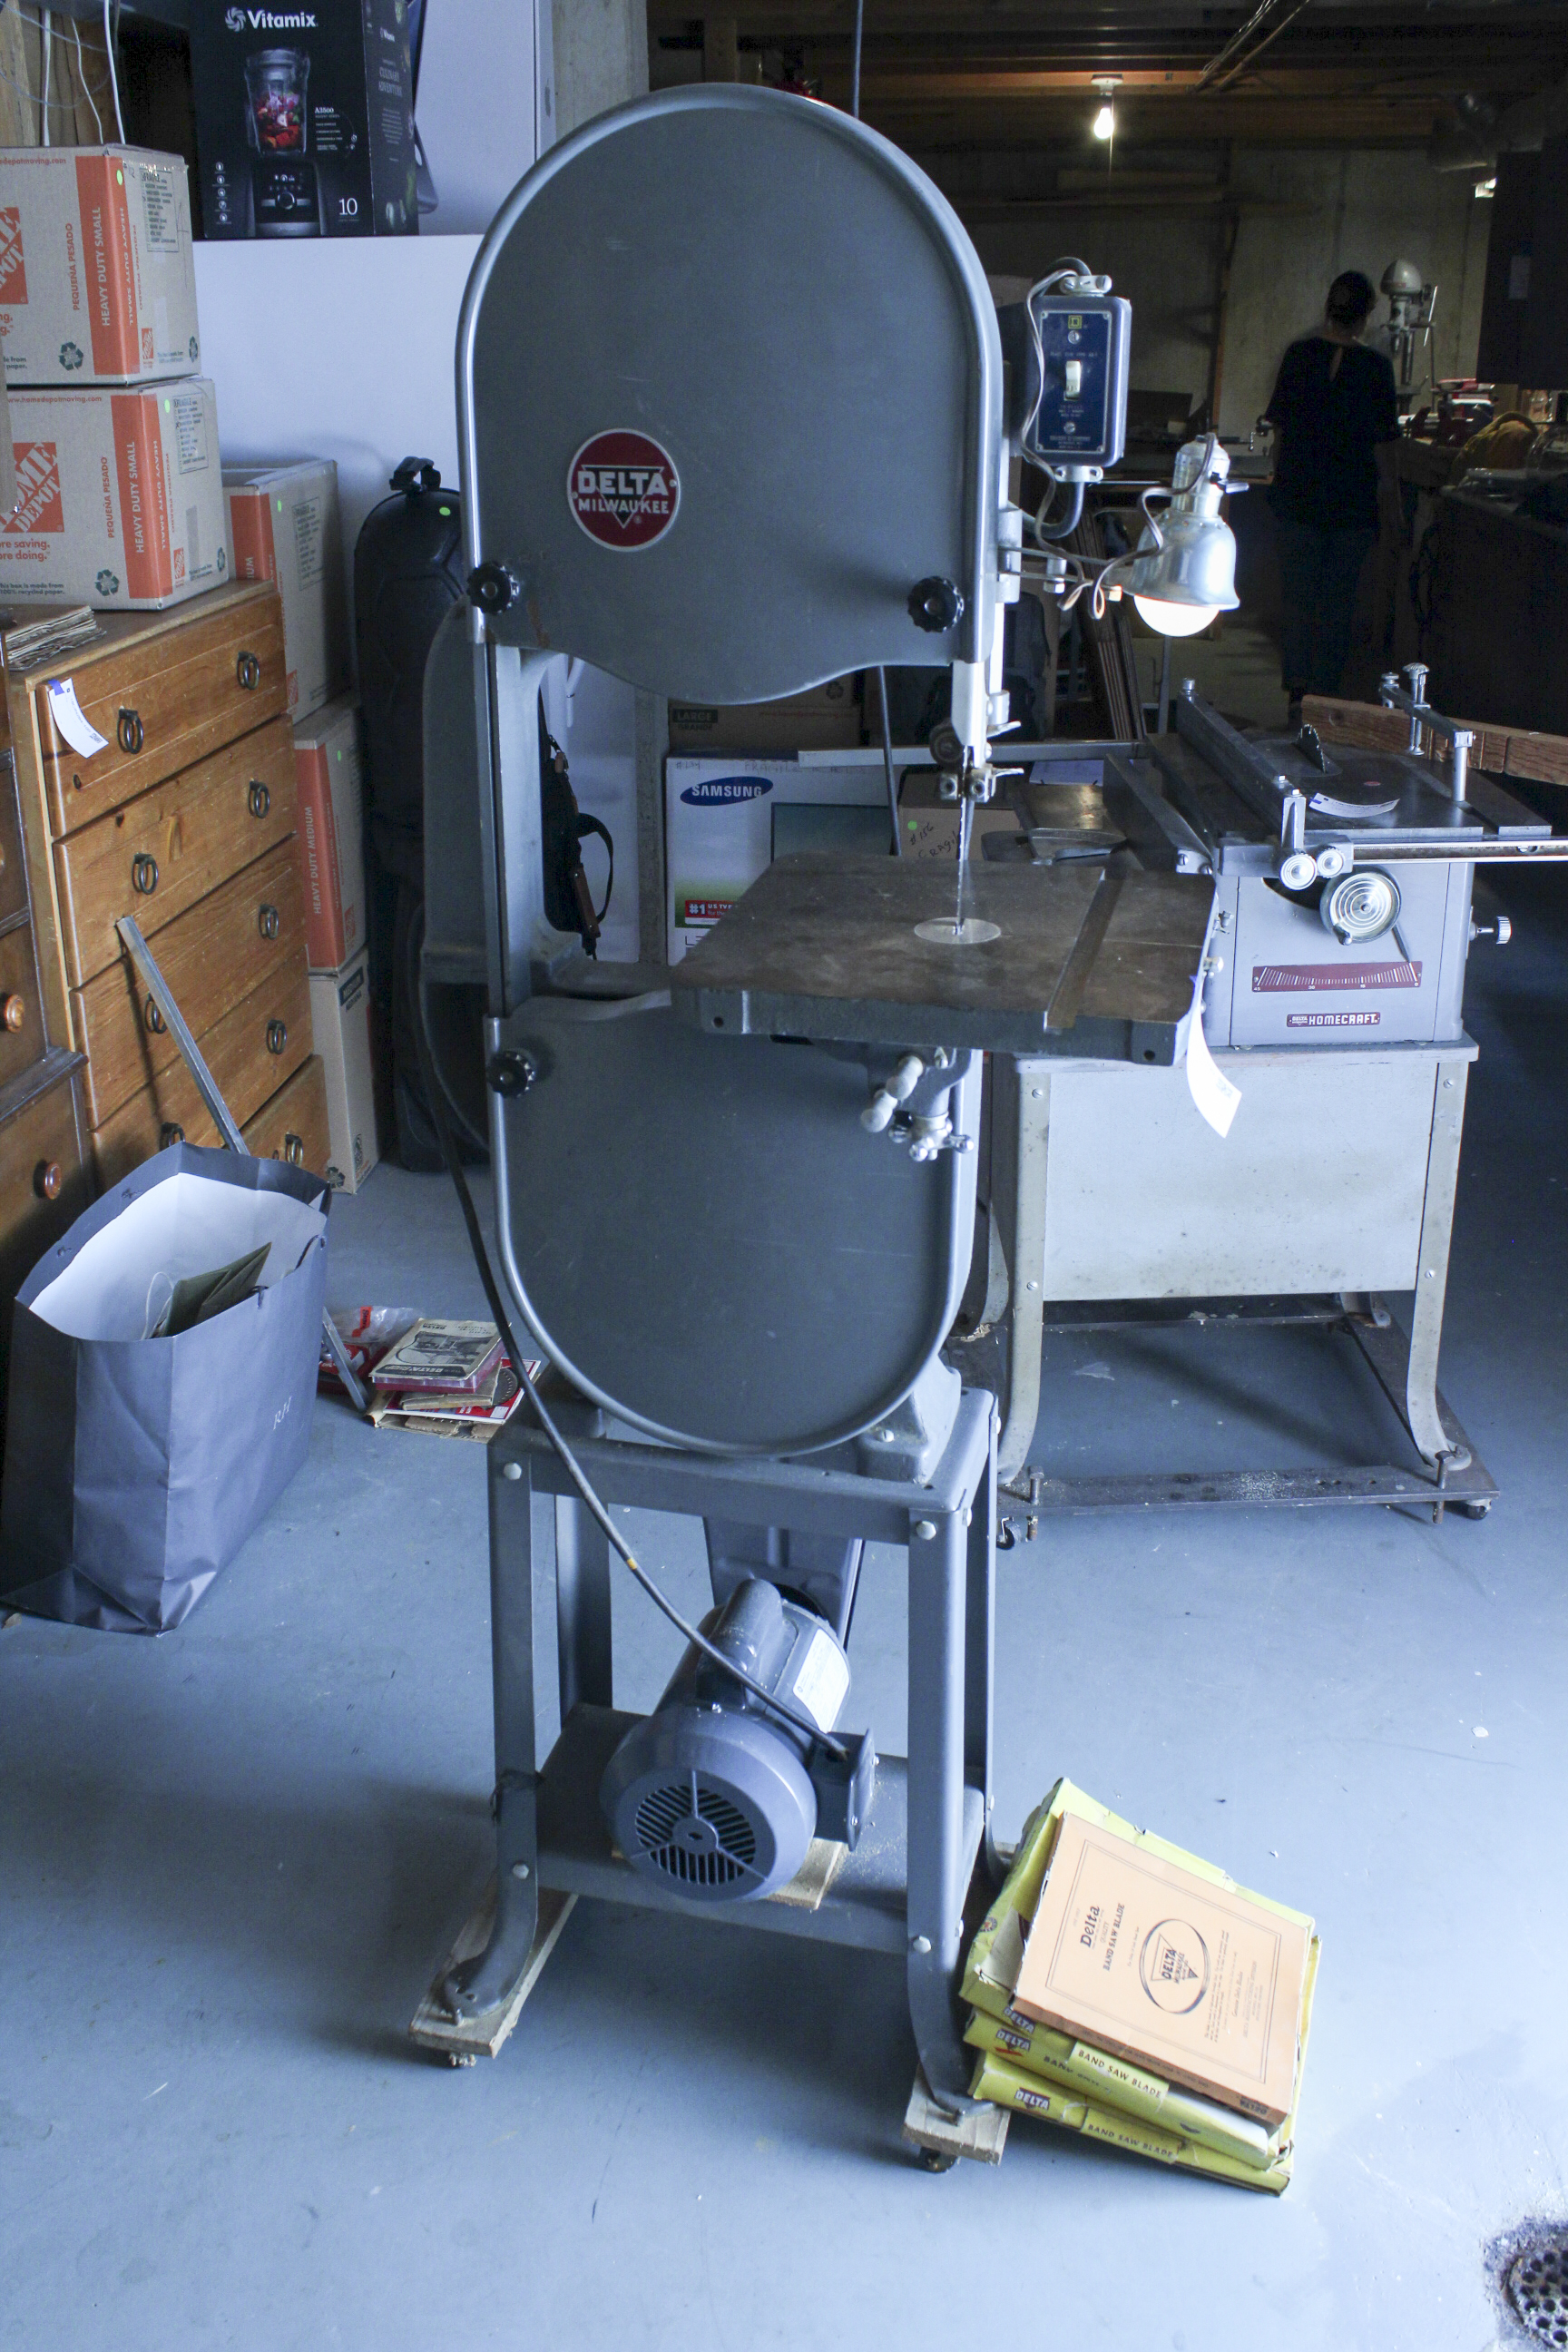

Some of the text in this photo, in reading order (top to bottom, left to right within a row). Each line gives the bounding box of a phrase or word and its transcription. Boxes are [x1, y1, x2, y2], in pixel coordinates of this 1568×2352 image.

[247, 9, 316, 29] Vitamix
[338, 198, 358, 215] 10
[65, 223, 75, 261] PESADO
[119, 208, 127, 248] HEAVY
[92, 207, 110, 326] HEAVY DUTY SMALL
[101, 456, 111, 493] PESADO
[152, 440, 161, 477] HEAVY
[126, 442, 145, 554] HEAVY DUTY SMALL
[577, 470, 669, 496] DELTA
[578, 498, 669, 514] MILWAUKEE
[14, 539, 50, 549] saving.
[677, 711, 712, 721] LARGE
[691, 783, 762, 798] SAMSUNG
[304, 806, 322, 915] HEAVY DUTY MEDIUM
[689, 903, 706, 915] #1
[1309, 1014, 1377, 1025] HOMECRAFT
[273, 1396, 292, 1431] RH
[1079, 1905, 1100, 1948] Delta
[1103, 1903, 1125, 1971] BAND SAW BLADE
[1161, 1949, 1176, 1980] DELTA
[995, 2030, 1031, 2052] DELTA
[1077, 2049, 1105, 2069] BAND
[1108, 2065, 1130, 2082] SAW
[1132, 2078, 1161, 2099] BLADE
[1014, 2090, 1050, 2111] DELTA
[1088, 2124, 1173, 2159] BAND SAW BLADE
